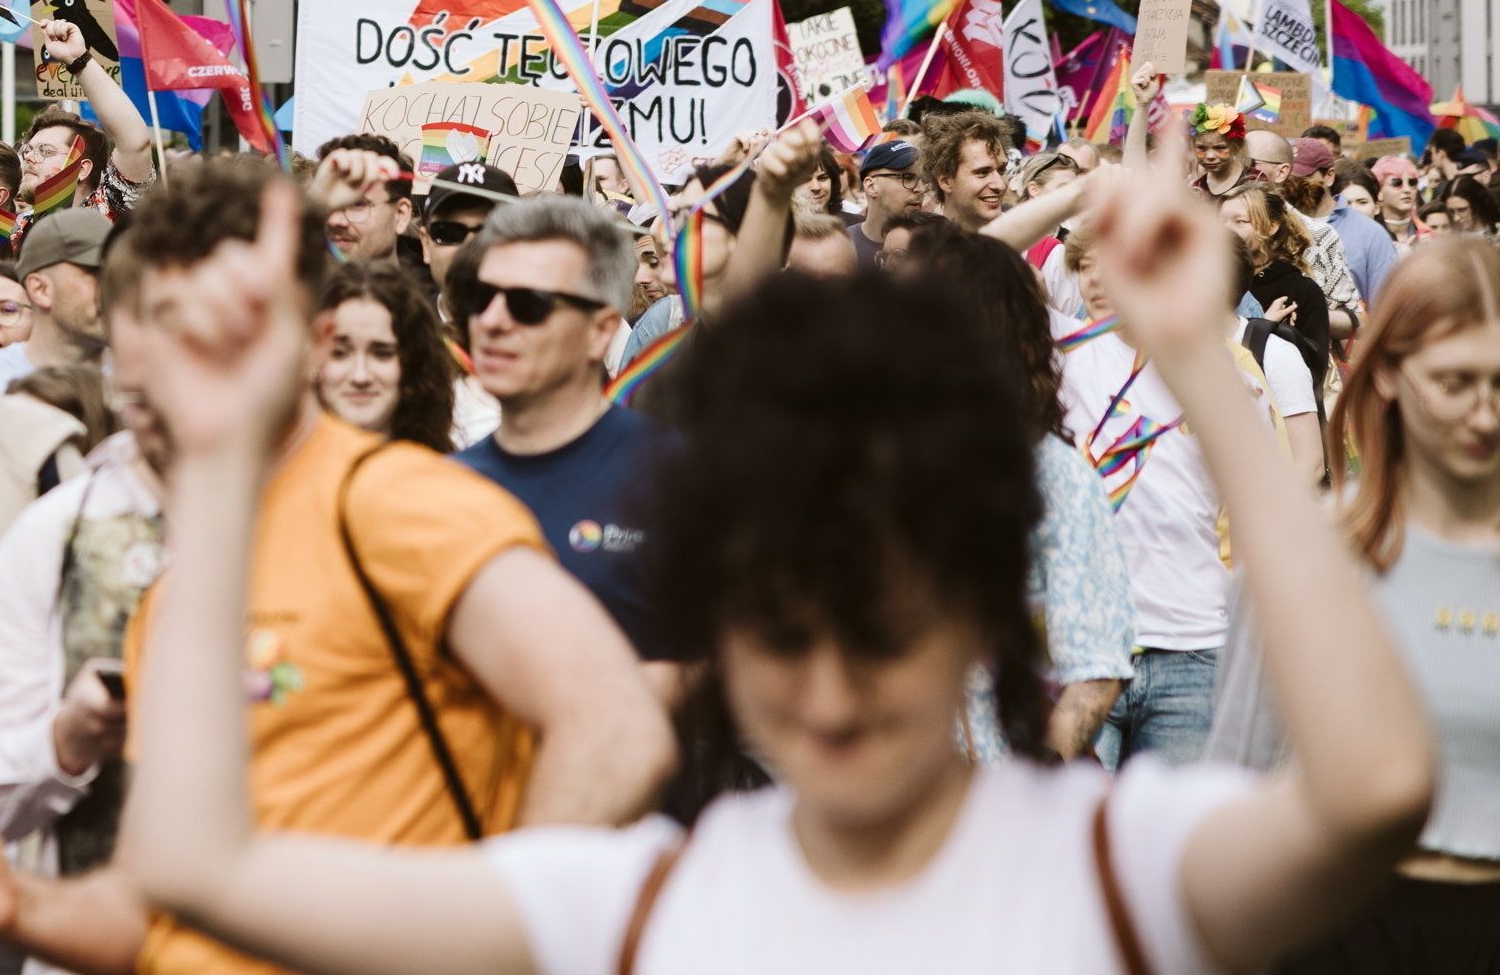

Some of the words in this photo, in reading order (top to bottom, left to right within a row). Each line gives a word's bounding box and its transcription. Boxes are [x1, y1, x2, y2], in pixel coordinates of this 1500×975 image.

[356, 13, 475, 75] DOŚĆ
[1262, 22, 1321, 69] SZCZECIN
[43, 81, 67, 97] deal
[491, 96, 577, 145] SOBIE
[457, 162, 486, 184] NY
